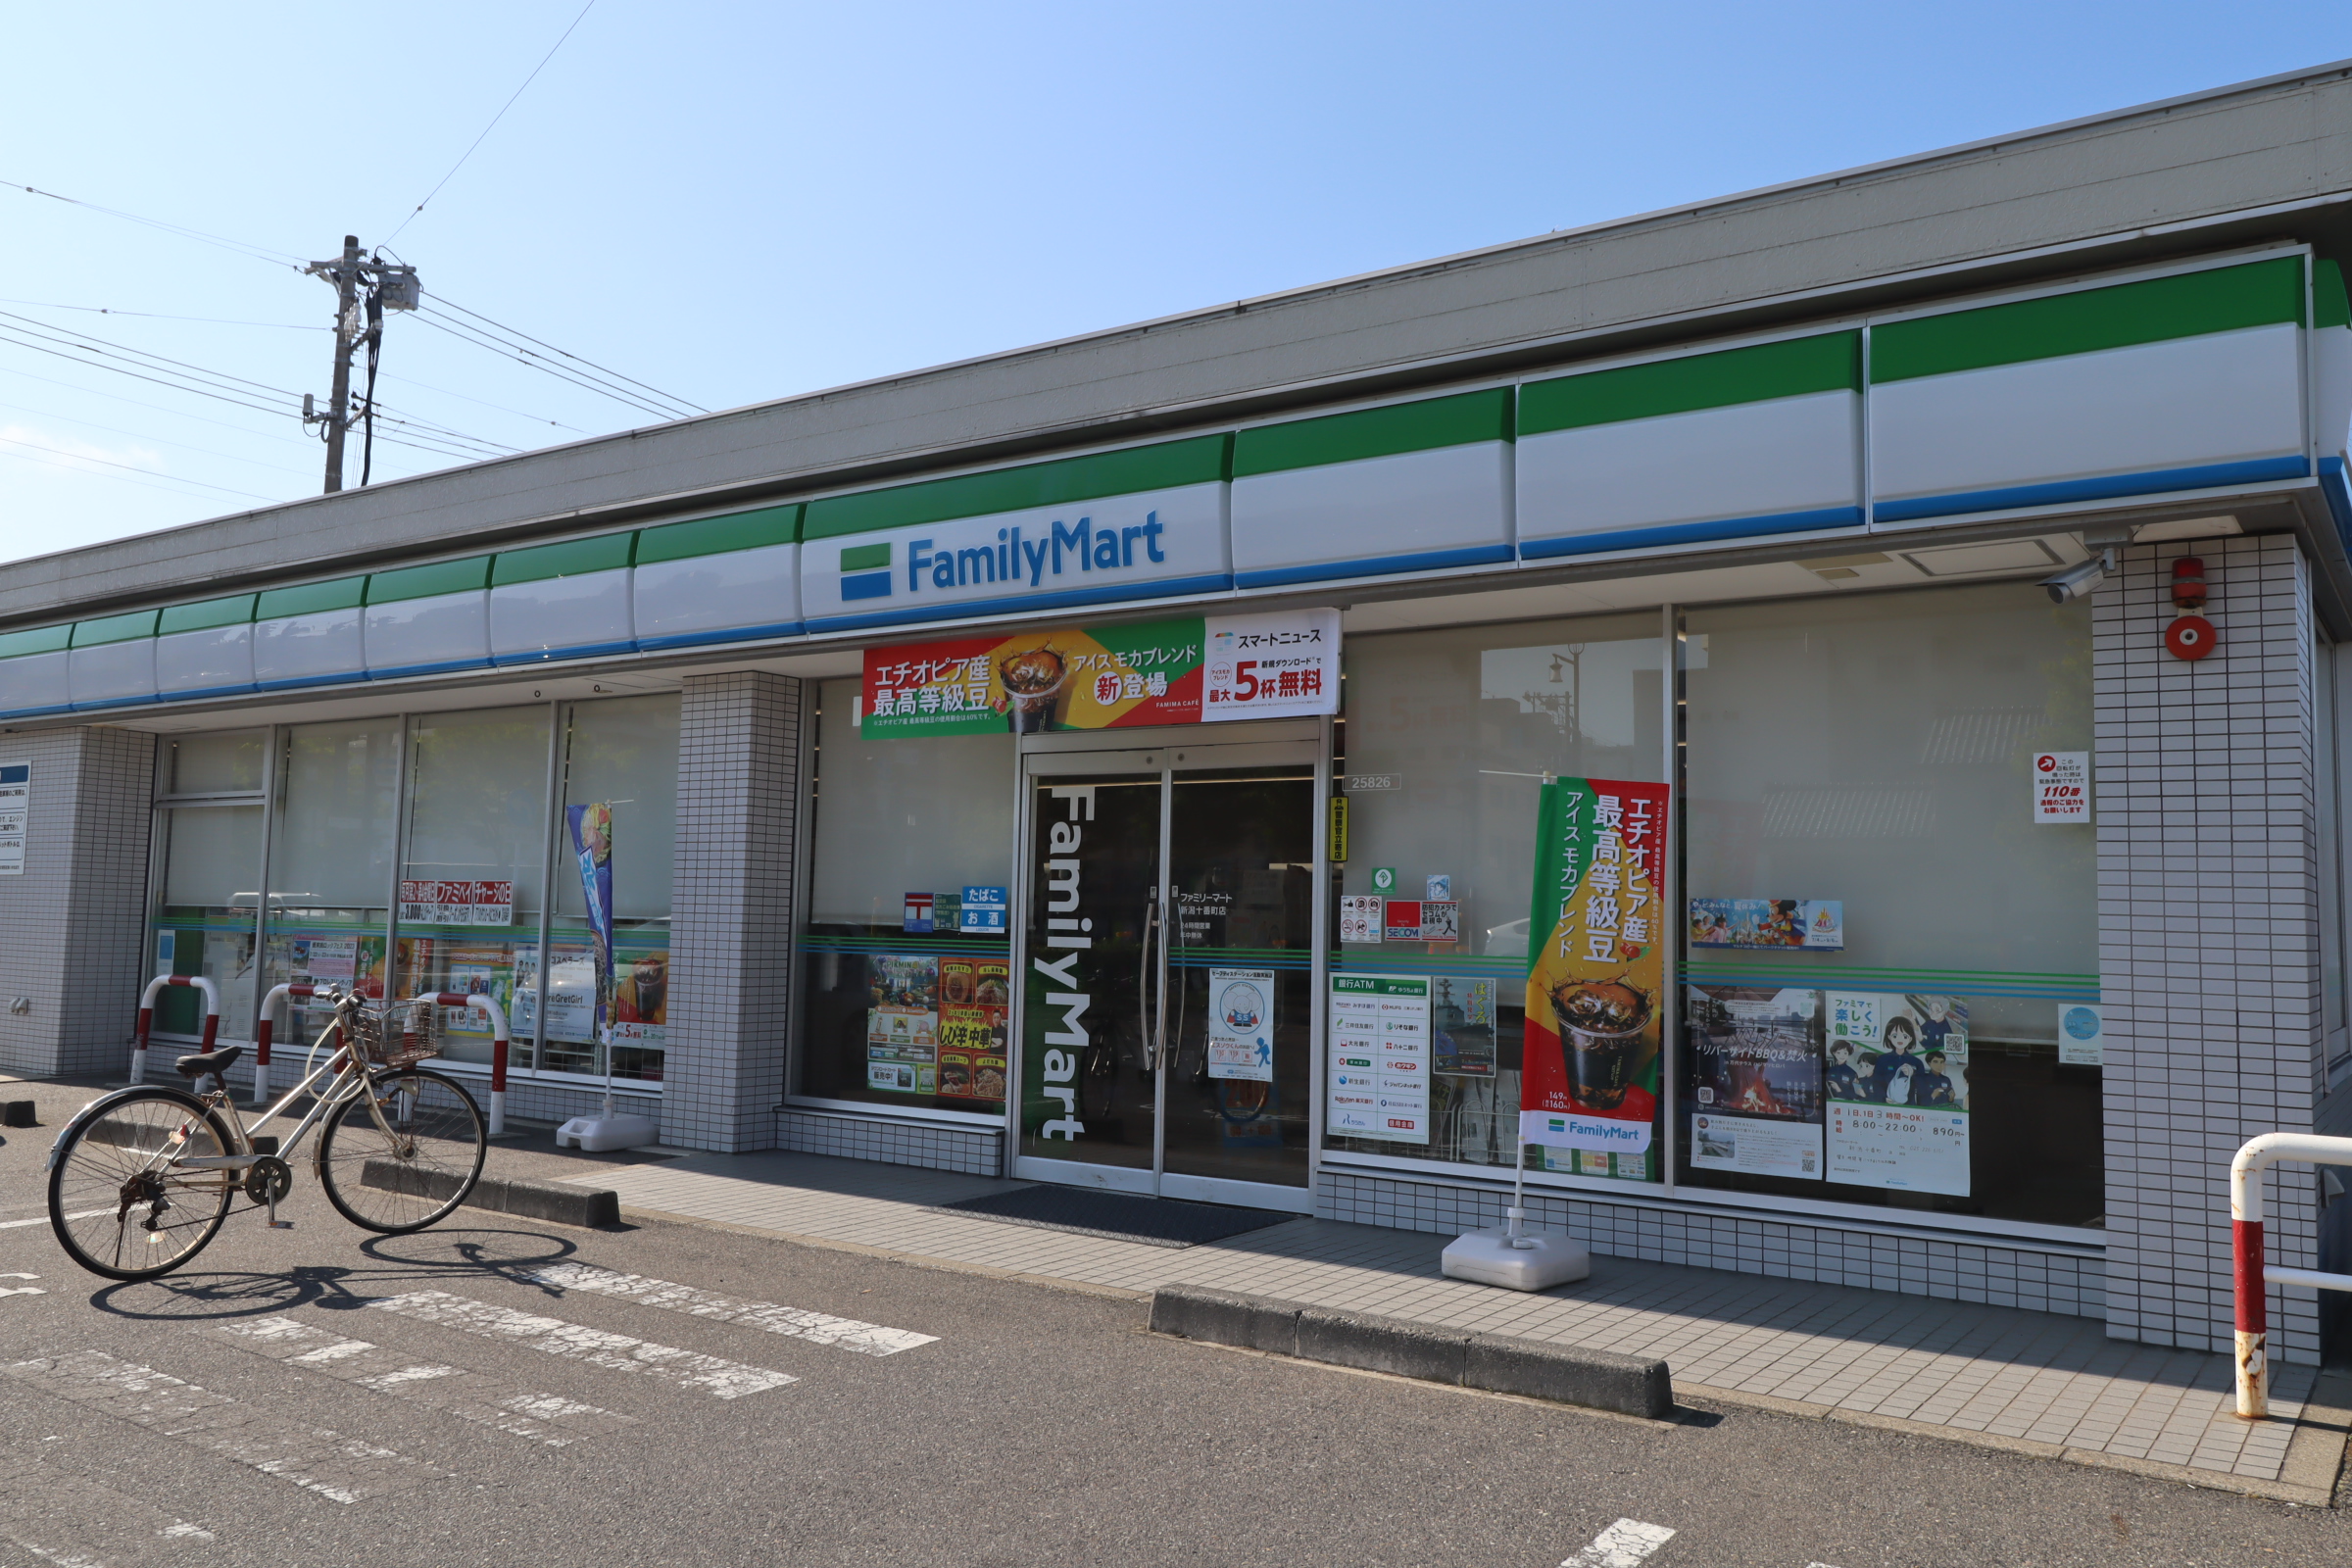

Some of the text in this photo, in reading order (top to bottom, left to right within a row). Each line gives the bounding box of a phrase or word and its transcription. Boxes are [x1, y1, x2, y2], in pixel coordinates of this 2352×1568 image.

[907, 509, 1165, 592] FamilyMart
[1238, 628, 1322, 650] スマートニュース
[874, 654, 992, 687] エチオピア産
[1096, 671, 1169, 702] 新登場
[872, 680, 992, 718] 最高等級豆
[1182, 698, 1200, 707] CAFÉ
[1351, 776, 1392, 789] 25826
[2043, 785, 2082, 798] 110番
[1334, 810, 1344, 860] 警察官立寄店
[1621, 798, 1653, 944] エチオピア産
[1583, 794, 1625, 964] 最高等級豆
[437, 882, 473, 903] ファミペイ
[474, 882, 513, 904] チャージの日
[968, 888, 1000, 902] たばこ
[1180, 893, 1233, 904] ファミリーマート
[967, 910, 1000, 926] お酒
[1180, 906, 1227, 916] 新潟十番町店
[1180, 931, 1203, 940] 年中無休
[1387, 927, 1419, 938] SECOM
[886, 960, 912, 969] PIKMIN
[1034, 786, 1095, 1142] FamilyMart
[1338, 978, 1375, 990] 銀行ATM
[1474, 982, 1488, 1025] はぐろ
[1835, 999, 1873, 1008] ファミマで
[1835, 1008, 1873, 1023] 楽しく
[1835, 1022, 1878, 1038] 働こう!
[1702, 1044, 1808, 1063] リバーサイドBBQ&焚火
[1348, 1077, 1371, 1086] 新生銀行
[1389, 1081, 1422, 1090] ジャパンネット銀行
[1548, 1091, 1568, 1101] 149円
[1389, 1120, 1414, 1129] 信用金庫
[1569, 1121, 1640, 1141] FamilyMart
